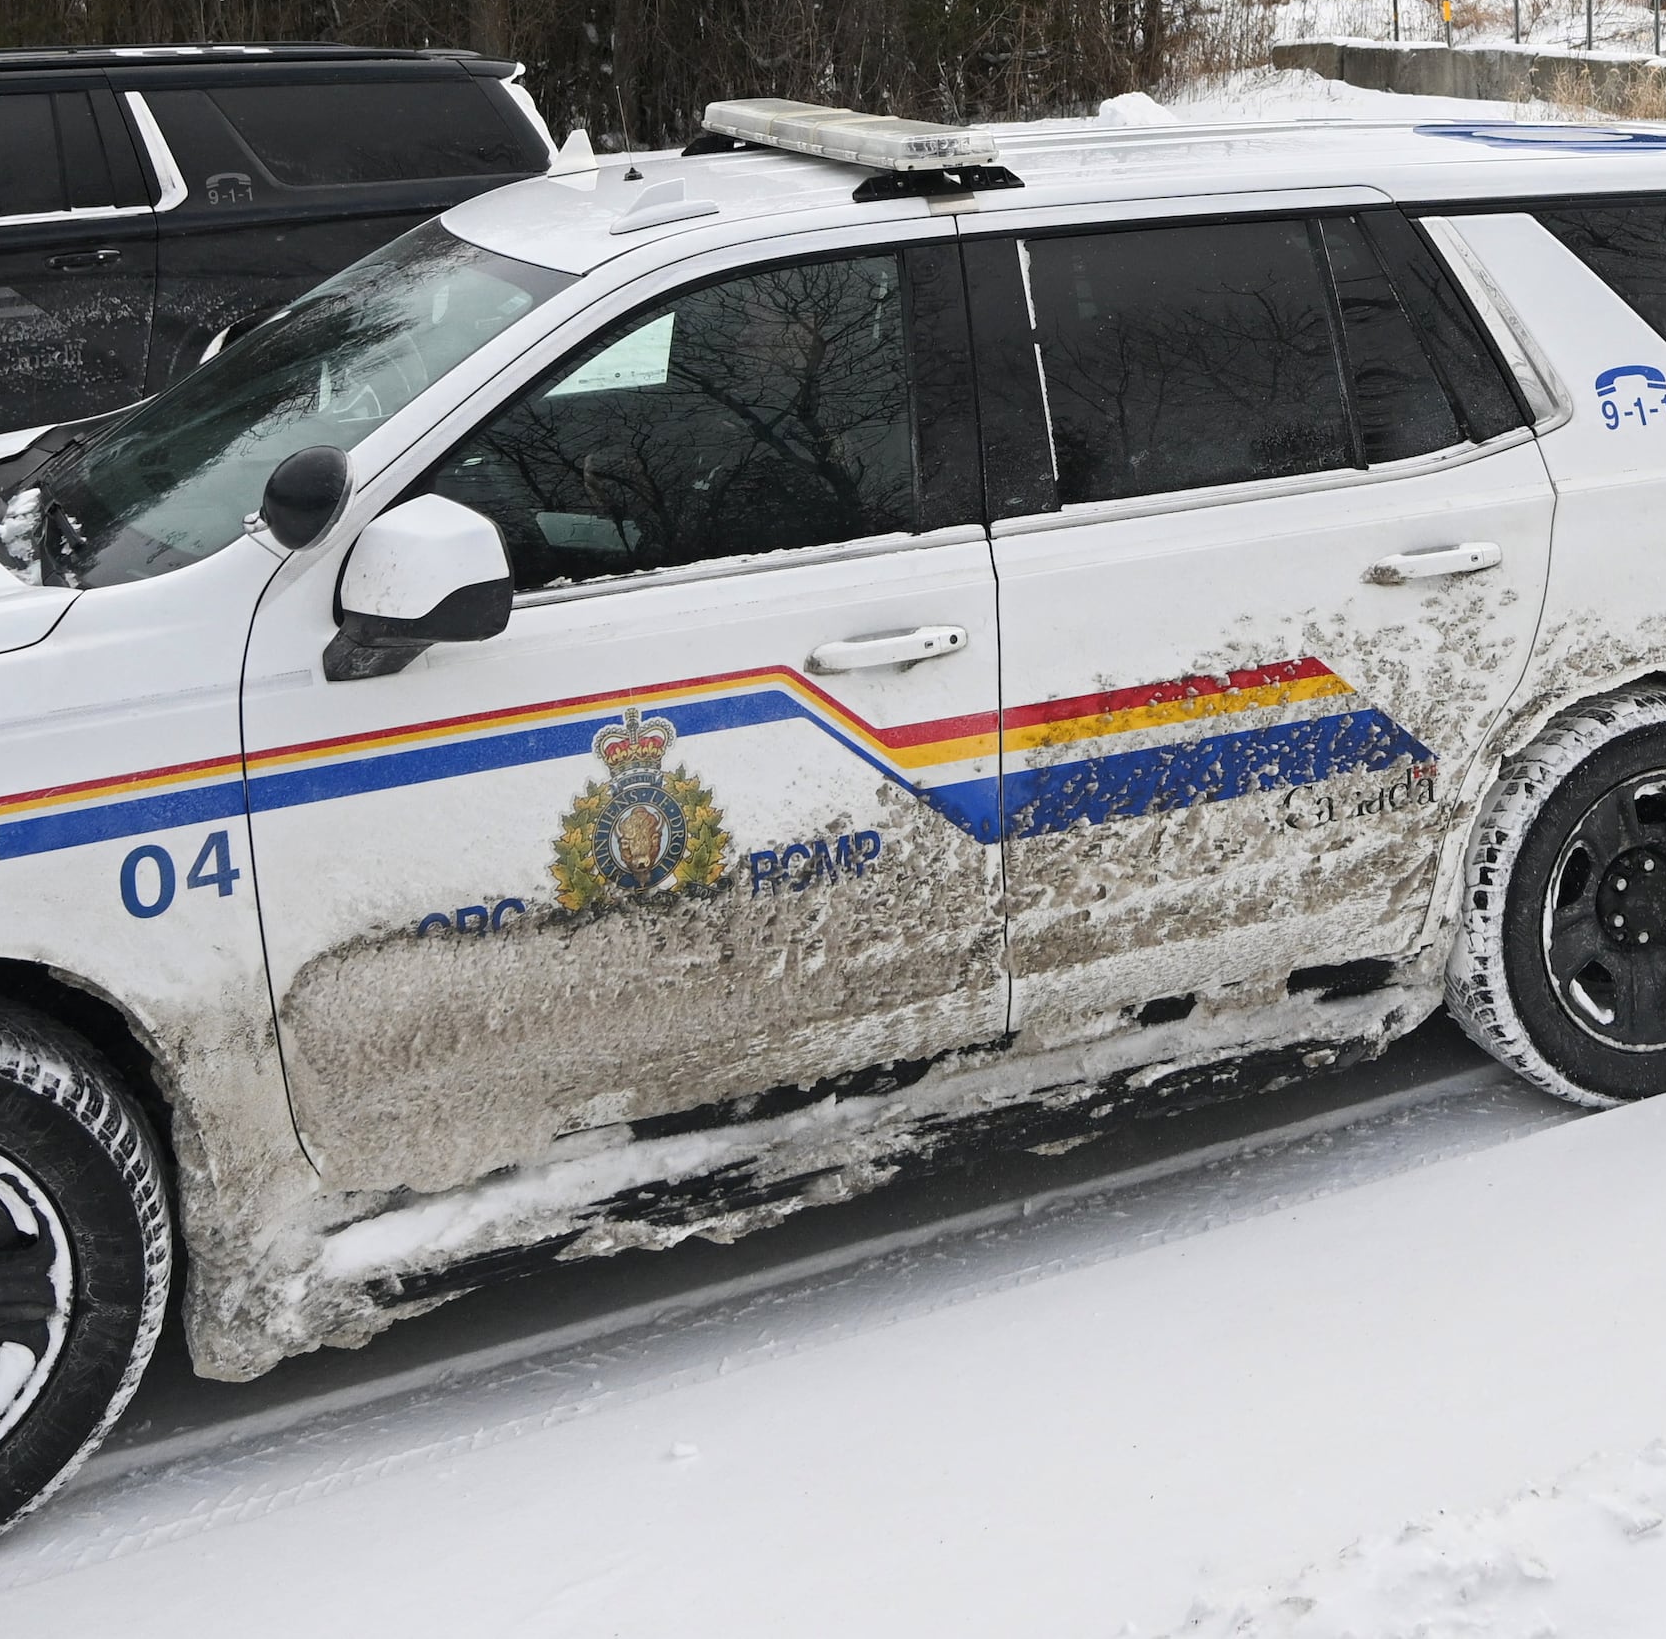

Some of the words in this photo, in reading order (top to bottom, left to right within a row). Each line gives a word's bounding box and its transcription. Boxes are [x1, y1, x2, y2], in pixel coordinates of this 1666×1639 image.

[207, 186, 254, 205] 9-1-1
[650, 791, 671, 810] LE
[119, 830, 240, 919] 04
[660, 815, 684, 875] DROIT
[750, 829, 881, 898] RCMP
